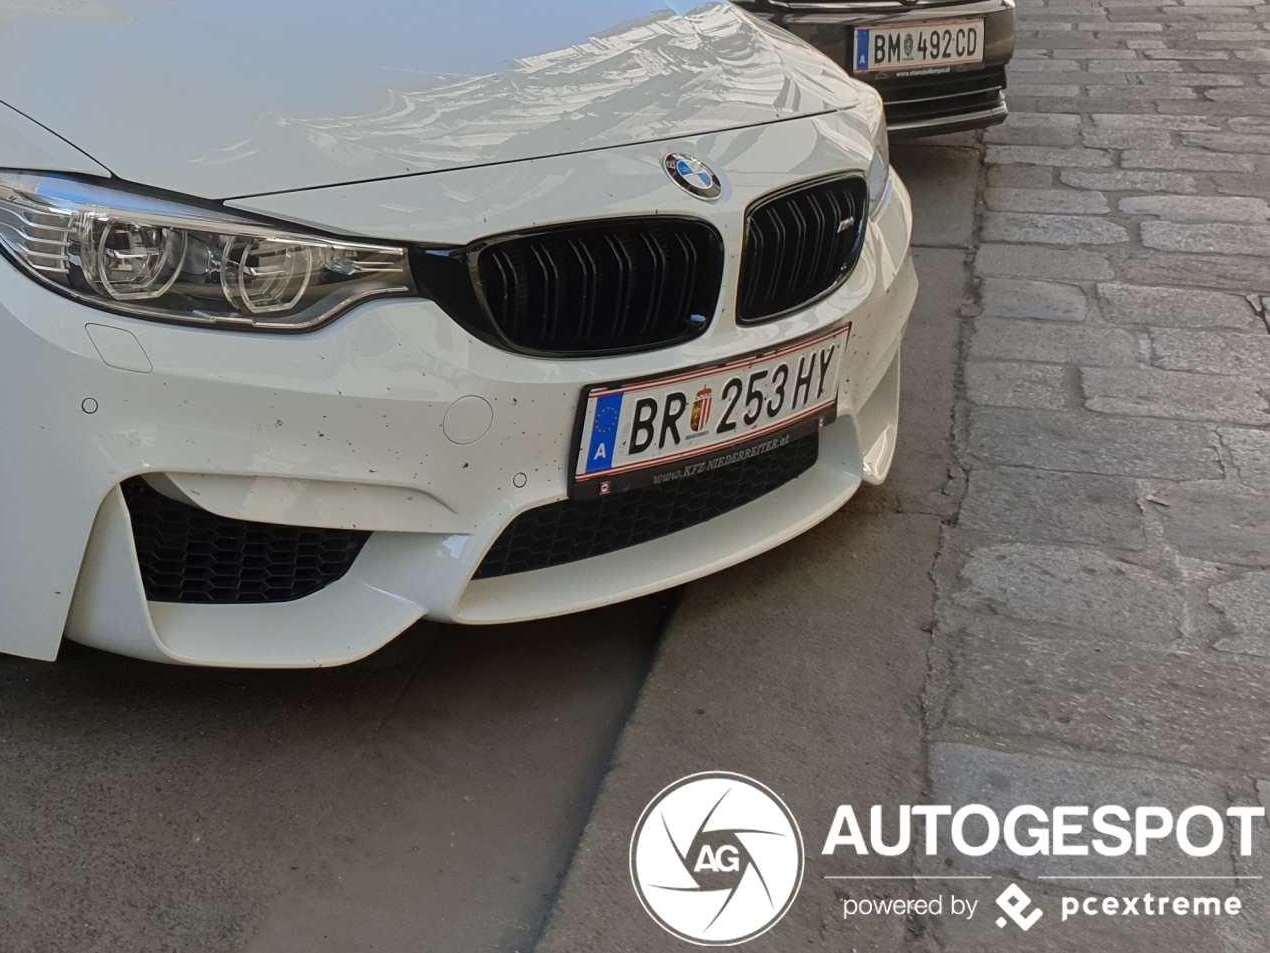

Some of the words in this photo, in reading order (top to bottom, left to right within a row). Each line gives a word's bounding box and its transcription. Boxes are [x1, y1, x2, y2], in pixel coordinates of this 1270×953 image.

[859, 55, 865, 64] A
[874, 32, 901, 63] BM
[628, 392, 687, 455] BR
[593, 443, 606, 461] A
